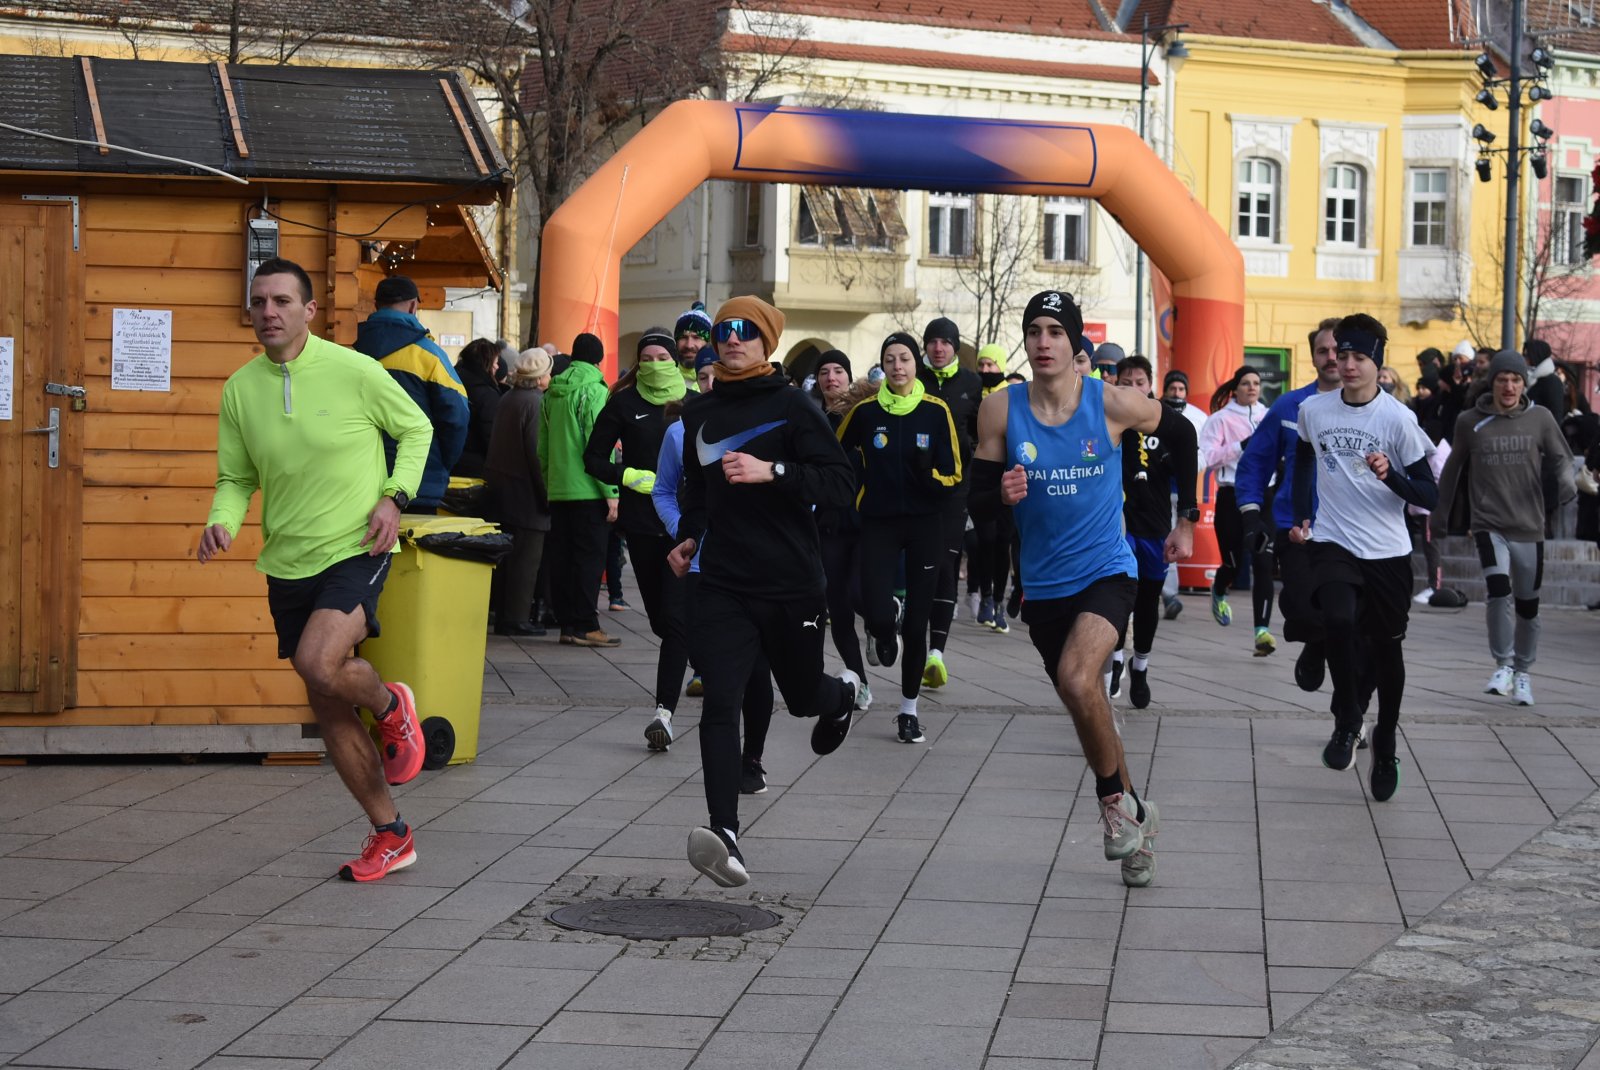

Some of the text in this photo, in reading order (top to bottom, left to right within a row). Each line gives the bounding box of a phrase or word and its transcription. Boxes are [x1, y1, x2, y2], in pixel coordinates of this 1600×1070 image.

[1025, 464, 1105, 481] PAI ATLÉTIKAI
[1046, 483, 1078, 496] CLUB
